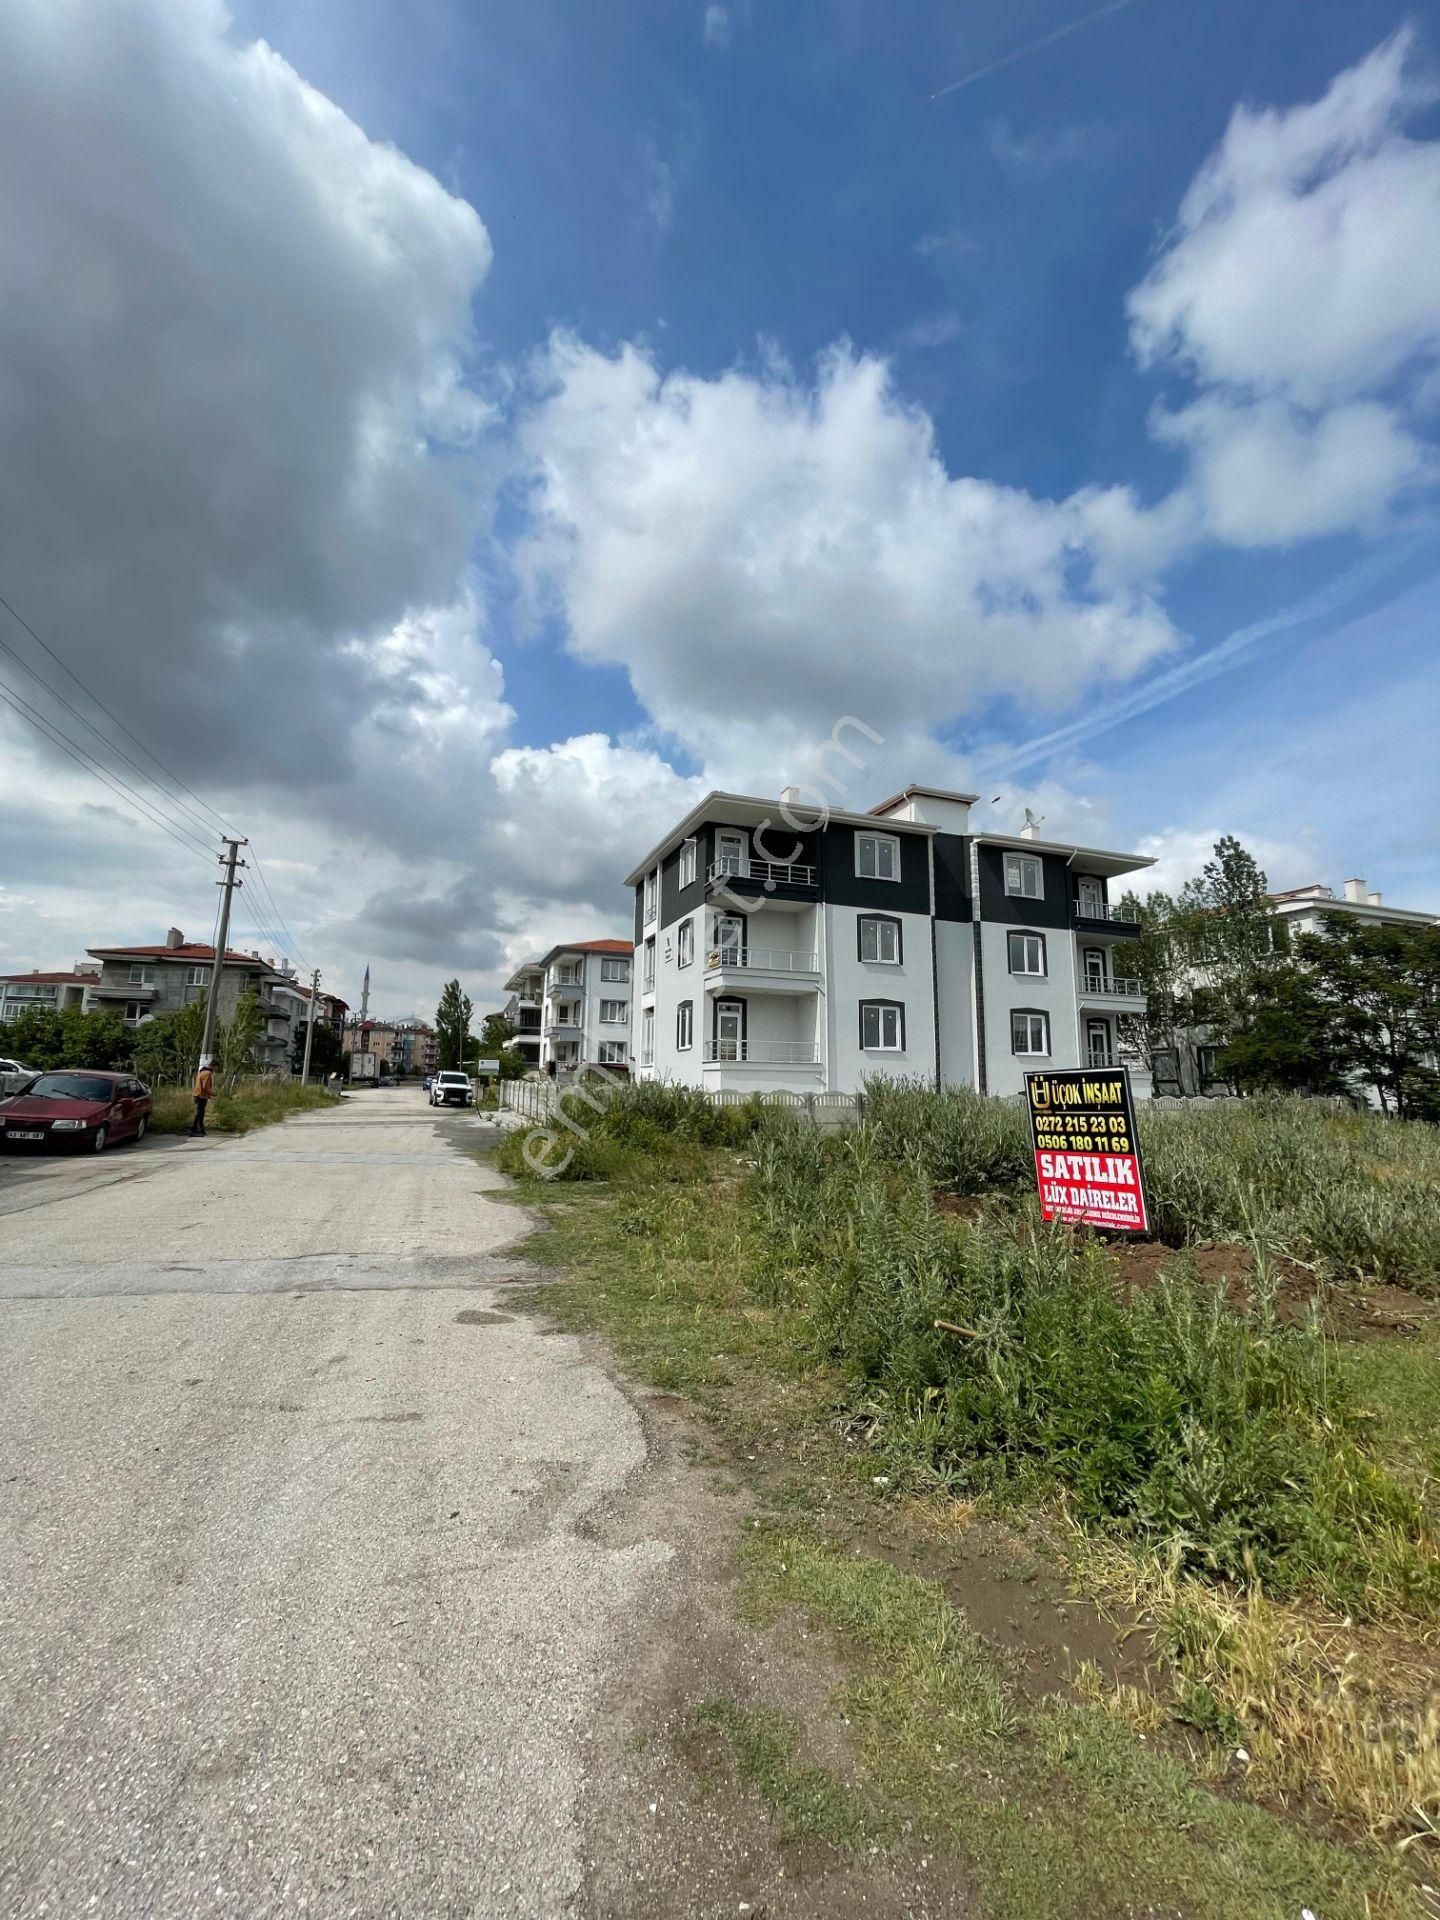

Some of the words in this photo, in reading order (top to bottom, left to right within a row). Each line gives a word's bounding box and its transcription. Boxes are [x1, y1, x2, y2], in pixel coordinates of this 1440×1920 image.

[1052, 1080, 1083, 1111] ÜÇOK
[1082, 1077, 1122, 1111] İNŞAAT
[1035, 1116, 1064, 1132] 0272
[1065, 1116, 1087, 1133] 215
[1090, 1116, 1107, 1133] 23
[1109, 1116, 1126, 1134] 03
[1037, 1135, 1068, 1150] 0506
[1069, 1135, 1093, 1151] 180
[1095, 1136, 1109, 1152] 11
[1111, 1137, 1130, 1153] 69
[1040, 1154, 1135, 1185] SATILIK
[1043, 1181, 1069, 1205] LÜX
[1069, 1184, 1139, 1213] DAİRELER
